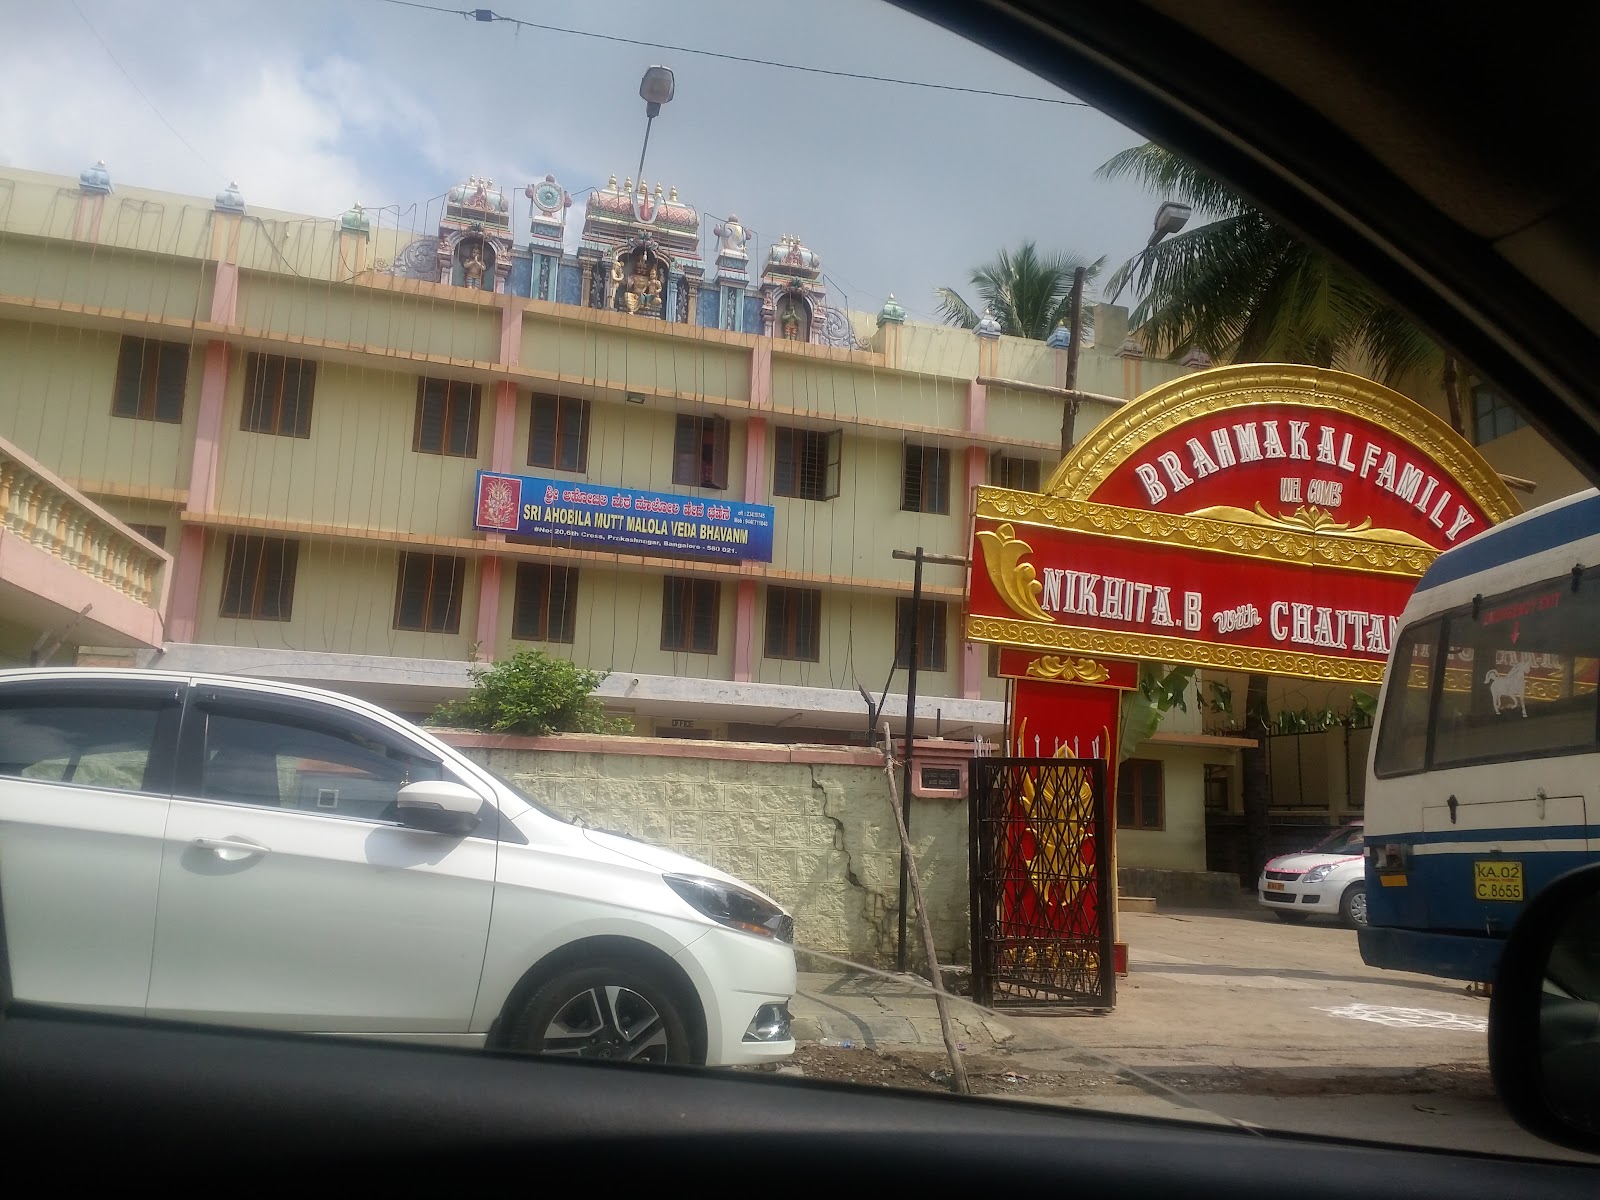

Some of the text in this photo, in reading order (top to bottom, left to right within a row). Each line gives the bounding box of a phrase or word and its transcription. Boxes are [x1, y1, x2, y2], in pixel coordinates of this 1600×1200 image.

[1359, 442, 1475, 541] FAMILY
[523, 504, 542, 521] SRI
[544, 506, 591, 527] AHOBILA
[594, 512, 624, 531] MUTT
[626, 516, 668, 535] MALOLA
[671, 520, 697, 539] VEDA
[581, 531, 605, 540] Cross,
[607, 534, 661, 547] Prakashnagar,
[663, 540, 700, 550] Bangalore
[1212, 603, 1262, 634] with
[671, 719, 694, 728] OFFICE
[1477, 865, 1520, 878] KA.02
[1478, 883, 1521, 898] C.8655
